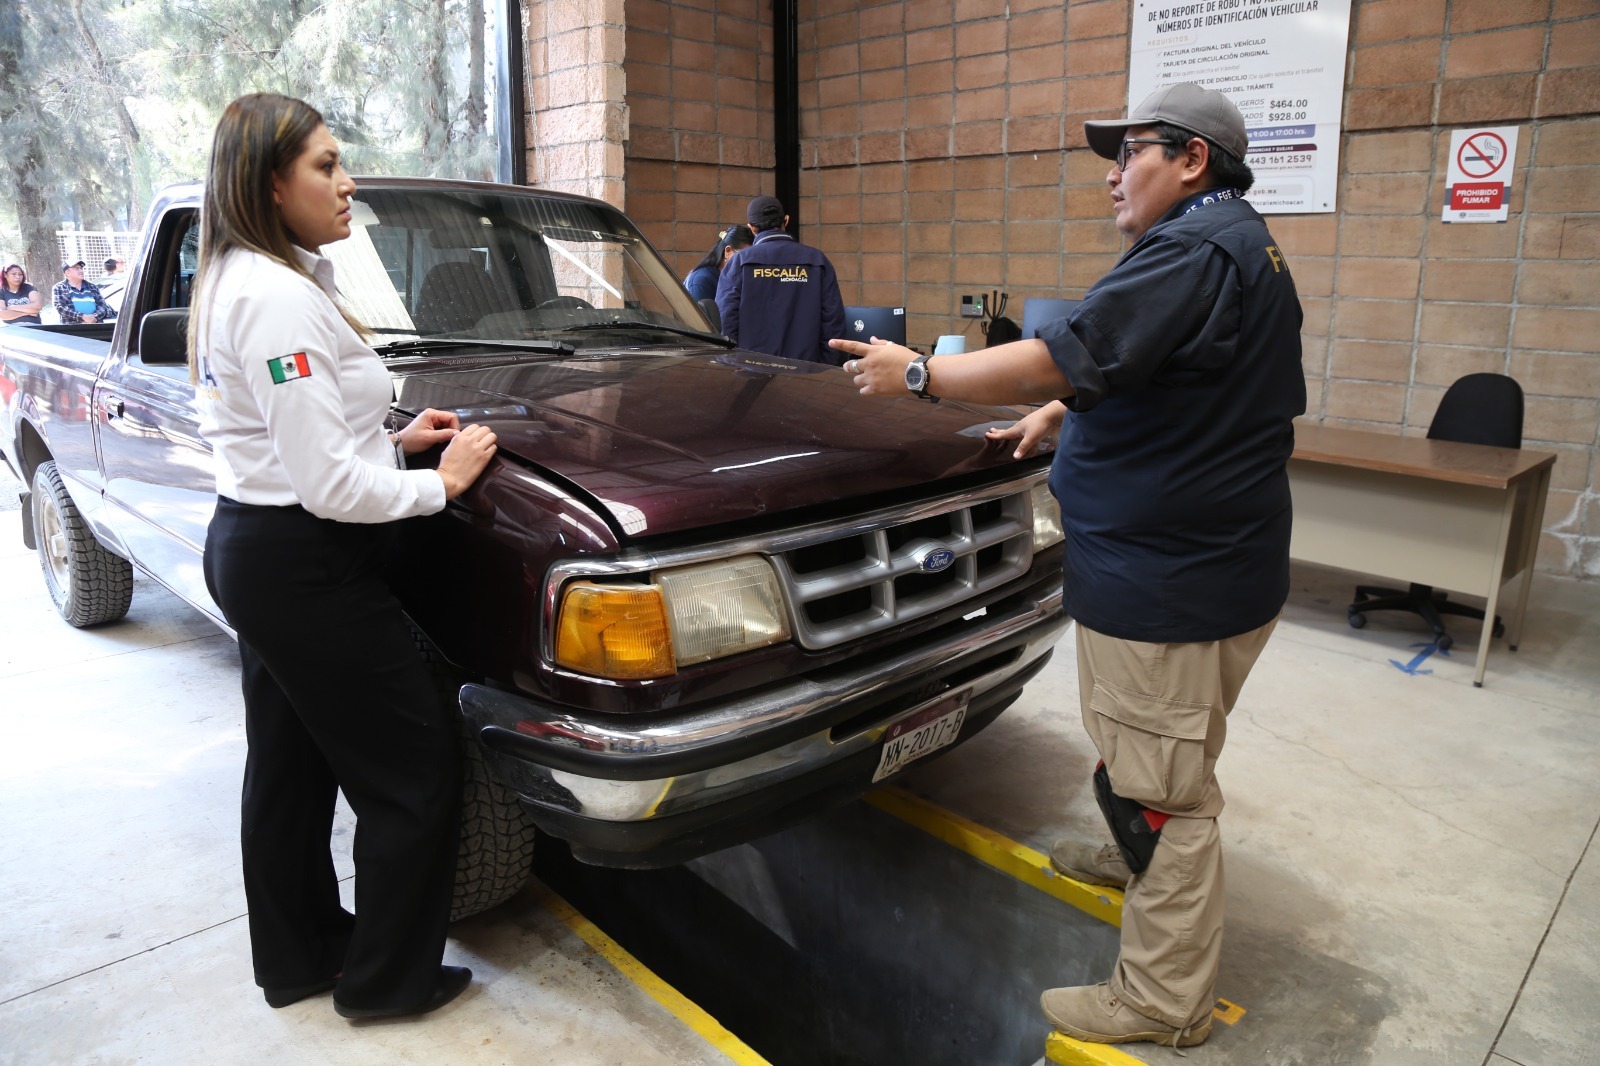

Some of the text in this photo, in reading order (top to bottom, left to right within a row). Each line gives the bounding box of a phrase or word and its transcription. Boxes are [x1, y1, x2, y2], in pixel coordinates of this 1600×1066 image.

[1148, 11, 1157, 22] DE
[1159, 9, 1170, 20] NO
[1172, 3, 1205, 18] REPORTE
[1206, 1, 1216, 12] DE
[1157, 0, 1318, 34] NÚMEROS DE IDENTIFICACIÓN VEHICULAR
[1147, 35, 1189, 46] REQUISITOS
[1163, 48, 1190, 57] FACTURA
[1191, 45, 1219, 53] ORIGINAL
[1234, 38, 1266, 48] VEHÍCULO
[1197, 52, 1239, 63] CIRCULACIÓN
[1240, 49, 1270, 58] ORIGINAL
[1246, 83, 1274, 91] TRÁMITE
[1270, 100, 1308, 109] $464.00
[1268, 111, 1306, 121] $928.00
[1249, 154, 1312, 164] 443 161 2539
[1217, 189, 1232, 201] FGE
[1456, 188, 1498, 196] PROHIBIDO
[1462, 196, 1490, 204] FUMAR
[753, 266, 808, 278] FISCALÍA
[930, 553, 949, 568] Ford
[881, 710, 964, 771] NN-2017-B
